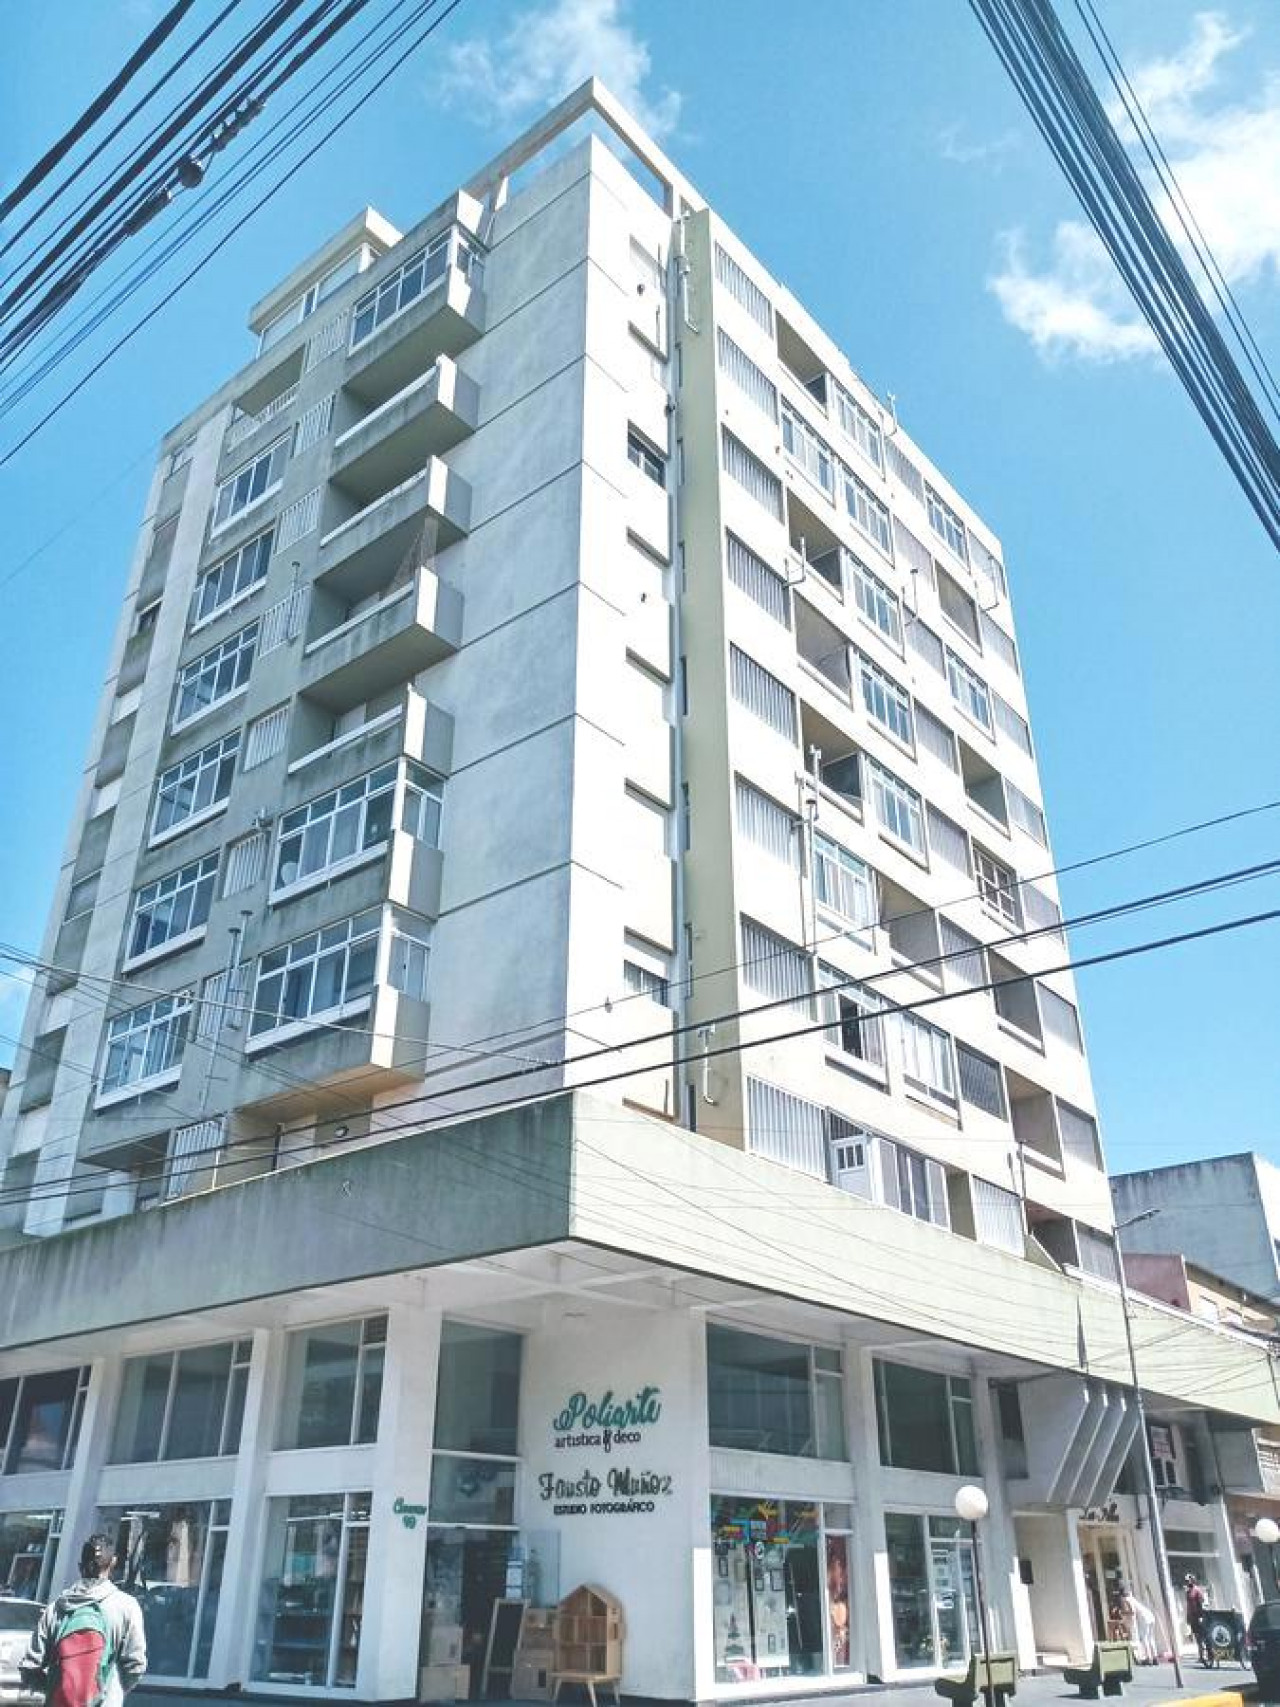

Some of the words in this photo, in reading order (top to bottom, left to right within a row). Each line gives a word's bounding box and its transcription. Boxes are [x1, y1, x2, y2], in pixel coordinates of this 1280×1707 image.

[553, 1386, 661, 1431] Poliarte
[613, 1430, 641, 1444] deco
[538, 1469, 601, 1500] Fausto
[607, 1466, 673, 1497] Muñoz
[553, 1503, 587, 1515] ESTUDIO
